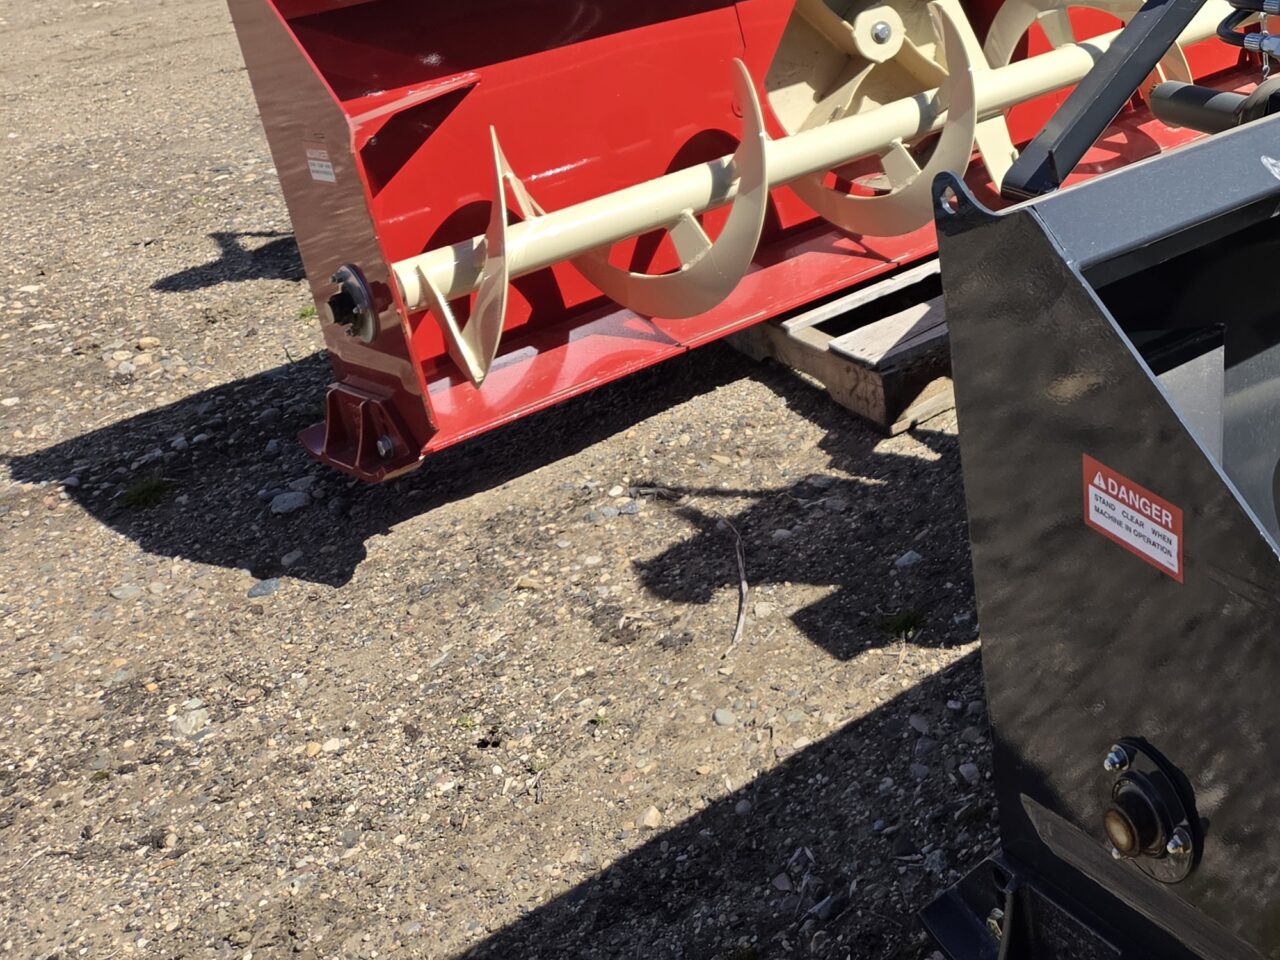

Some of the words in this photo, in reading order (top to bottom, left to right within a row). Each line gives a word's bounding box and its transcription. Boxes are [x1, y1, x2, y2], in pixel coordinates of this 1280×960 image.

[1094, 493, 1116, 511] STAND
[1121, 510, 1145, 529] CLEAR
[1151, 527, 1173, 545] WHEN
[1108, 477, 1173, 529] DANGER
[1094, 505, 1123, 528] MACHINE
[1125, 523, 1132, 533] IN
[1132, 529, 1173, 557] OPERATION
